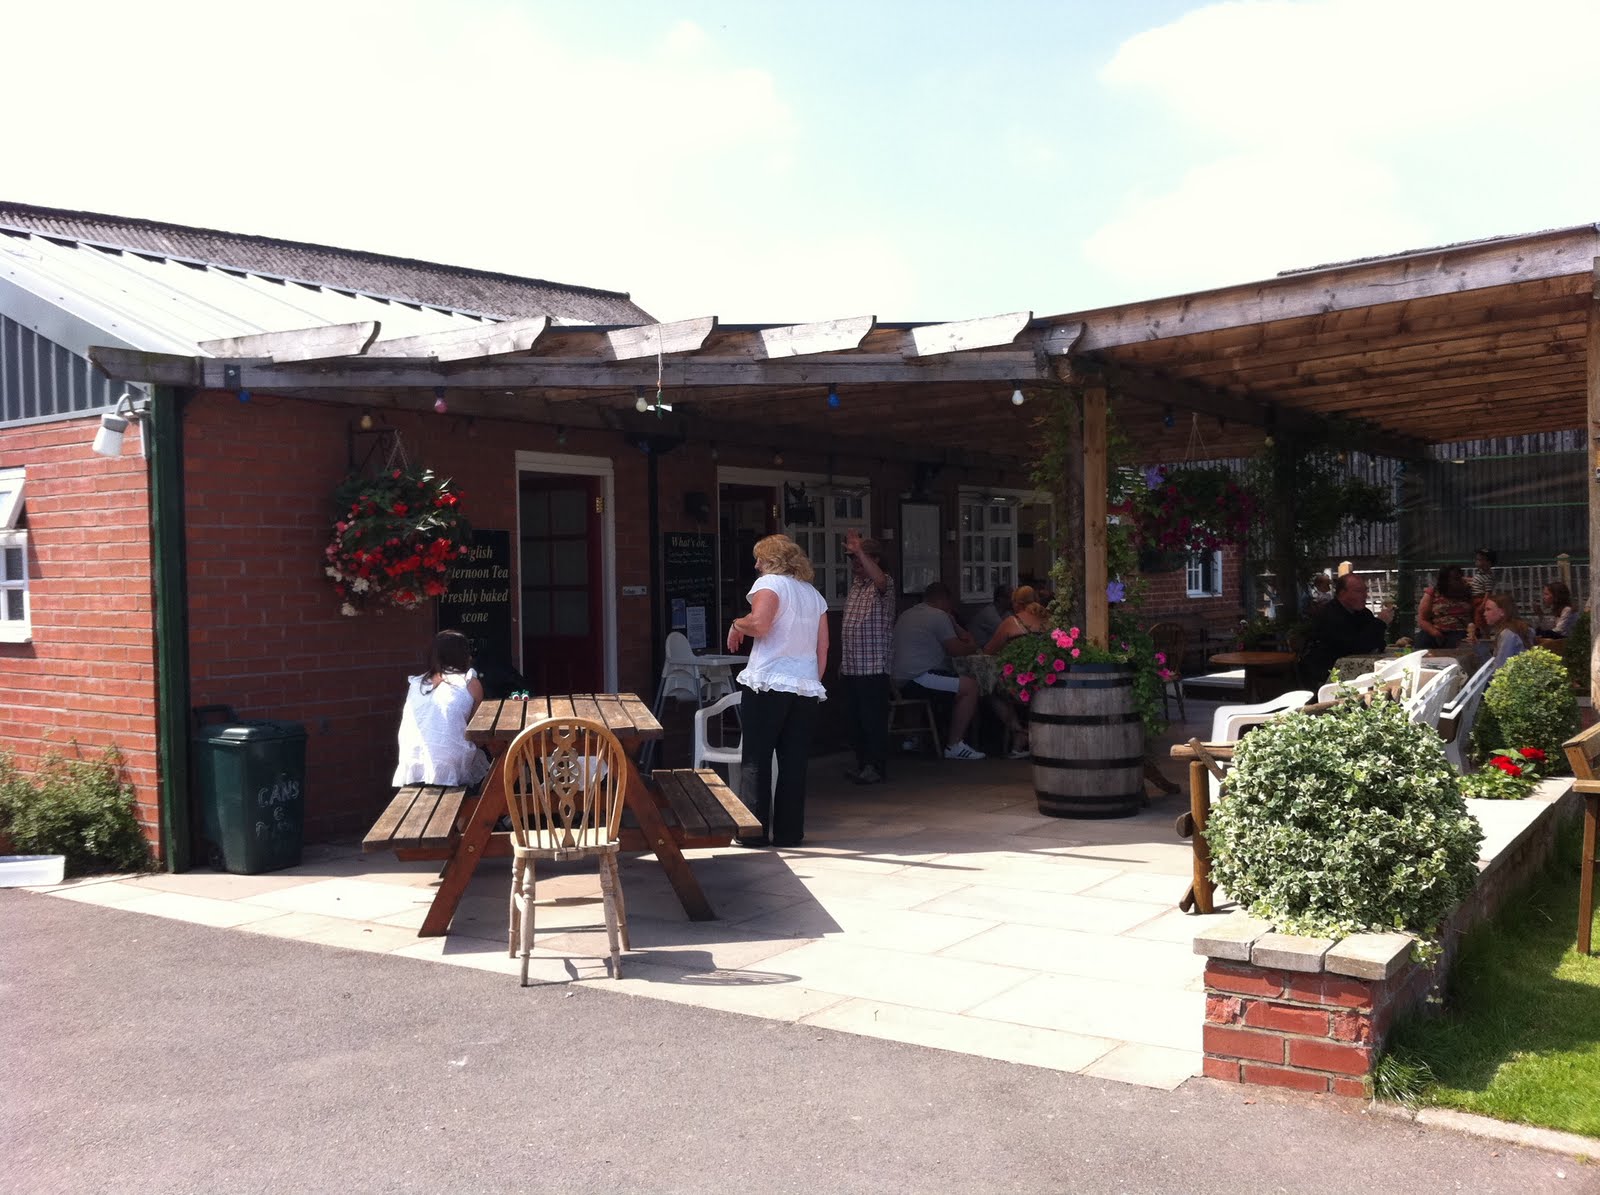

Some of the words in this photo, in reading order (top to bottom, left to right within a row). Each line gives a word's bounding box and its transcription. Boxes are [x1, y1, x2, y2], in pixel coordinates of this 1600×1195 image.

[460, 545, 493, 562] glish
[447, 566, 490, 579] ternoon
[491, 564, 509, 578] Tea
[440, 588, 479, 606] Freshly
[480, 588, 509, 603] baked
[461, 611, 489, 623] scone
[257, 780, 300, 808] CANS
